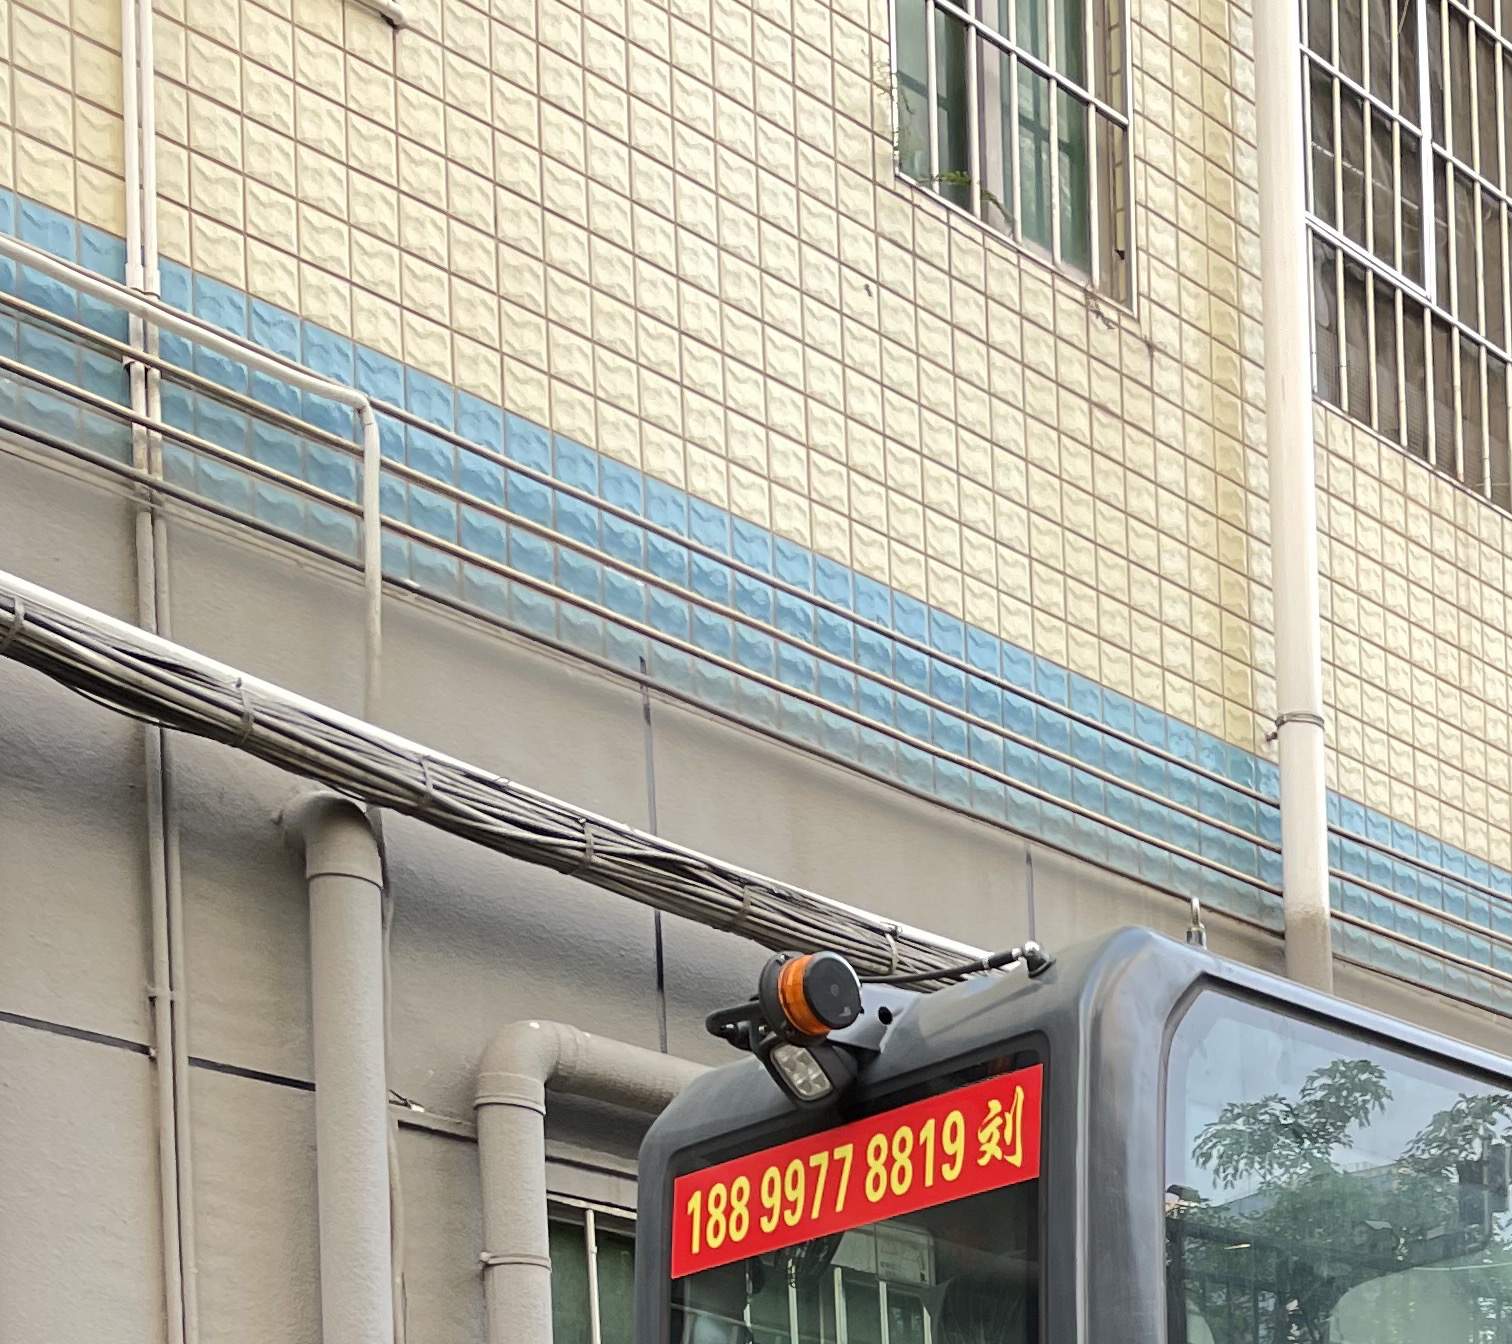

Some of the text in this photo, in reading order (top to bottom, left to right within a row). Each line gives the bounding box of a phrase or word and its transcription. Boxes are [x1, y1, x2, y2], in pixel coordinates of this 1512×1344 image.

[687, 1085, 1025, 1254] 188 9977 8819 刘
